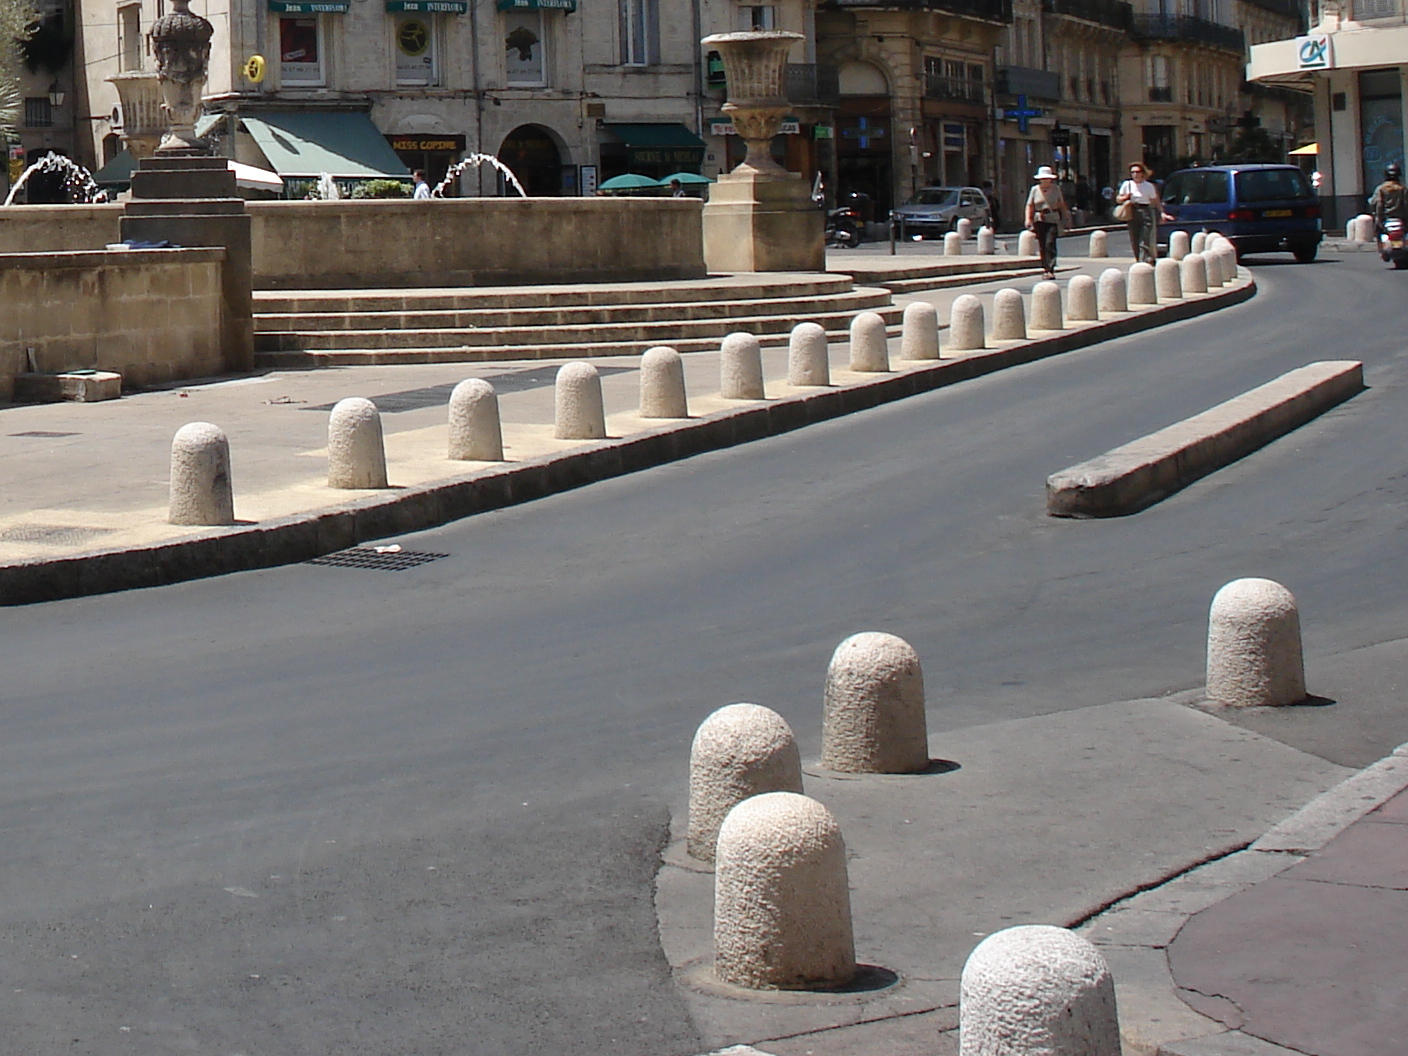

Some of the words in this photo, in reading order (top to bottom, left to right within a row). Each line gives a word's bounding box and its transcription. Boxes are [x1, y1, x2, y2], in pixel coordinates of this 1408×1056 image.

[427, 2, 463, 12] INTERFLORA
[393, 140, 419, 150] MISS
[420, 140, 457, 150] COPINE
